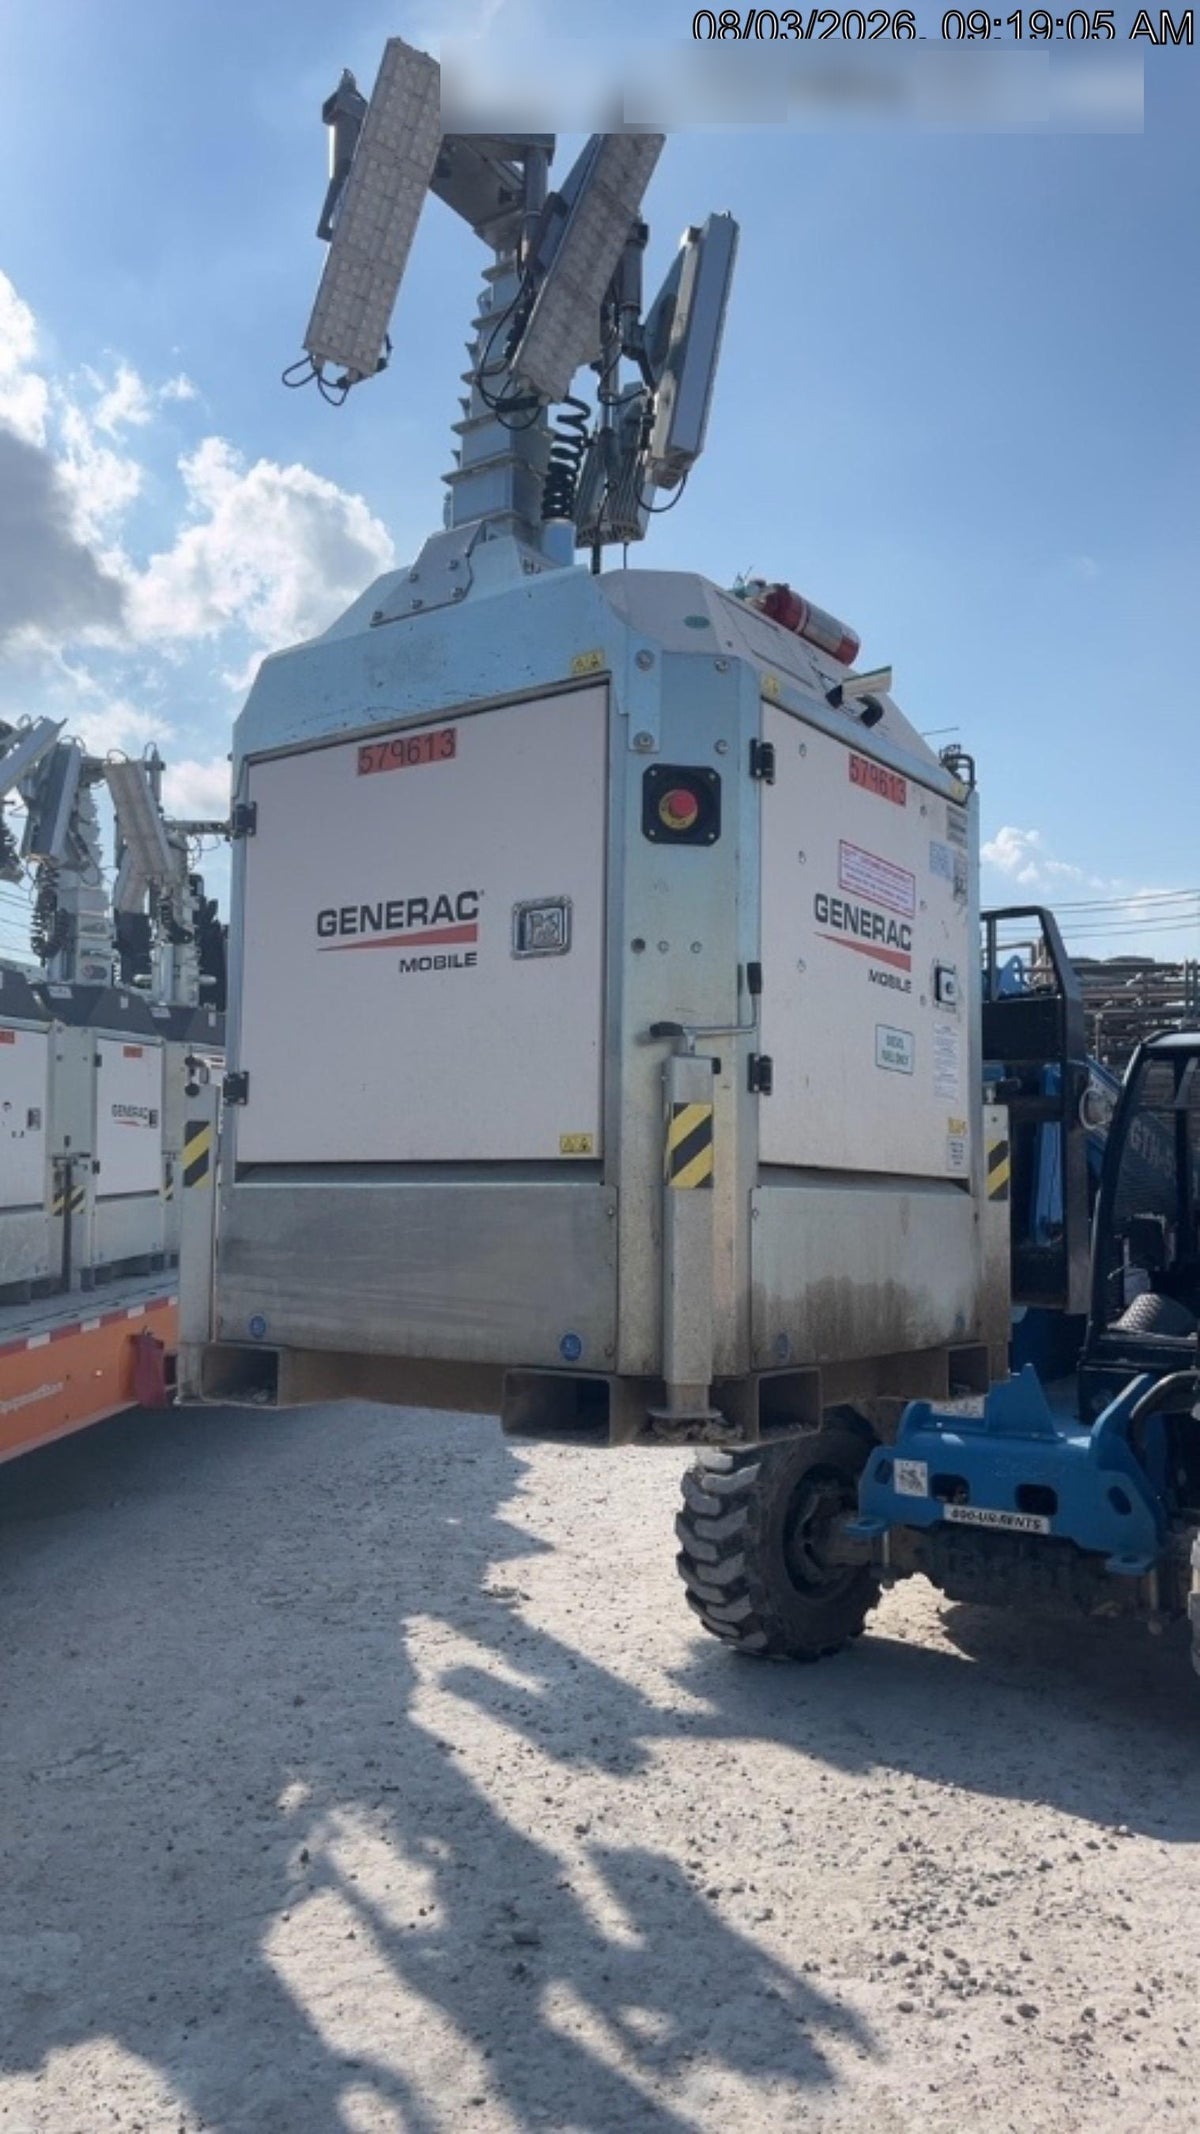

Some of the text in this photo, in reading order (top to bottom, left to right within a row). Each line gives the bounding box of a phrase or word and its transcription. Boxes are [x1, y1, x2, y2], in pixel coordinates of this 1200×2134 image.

[358, 728, 457, 774] 579613
[316, 890, 480, 938] GENERAC
[814, 893, 912, 952] GENERAC
[399, 952, 478, 974] MOBILE
[868, 968, 912, 994] MOBILE
